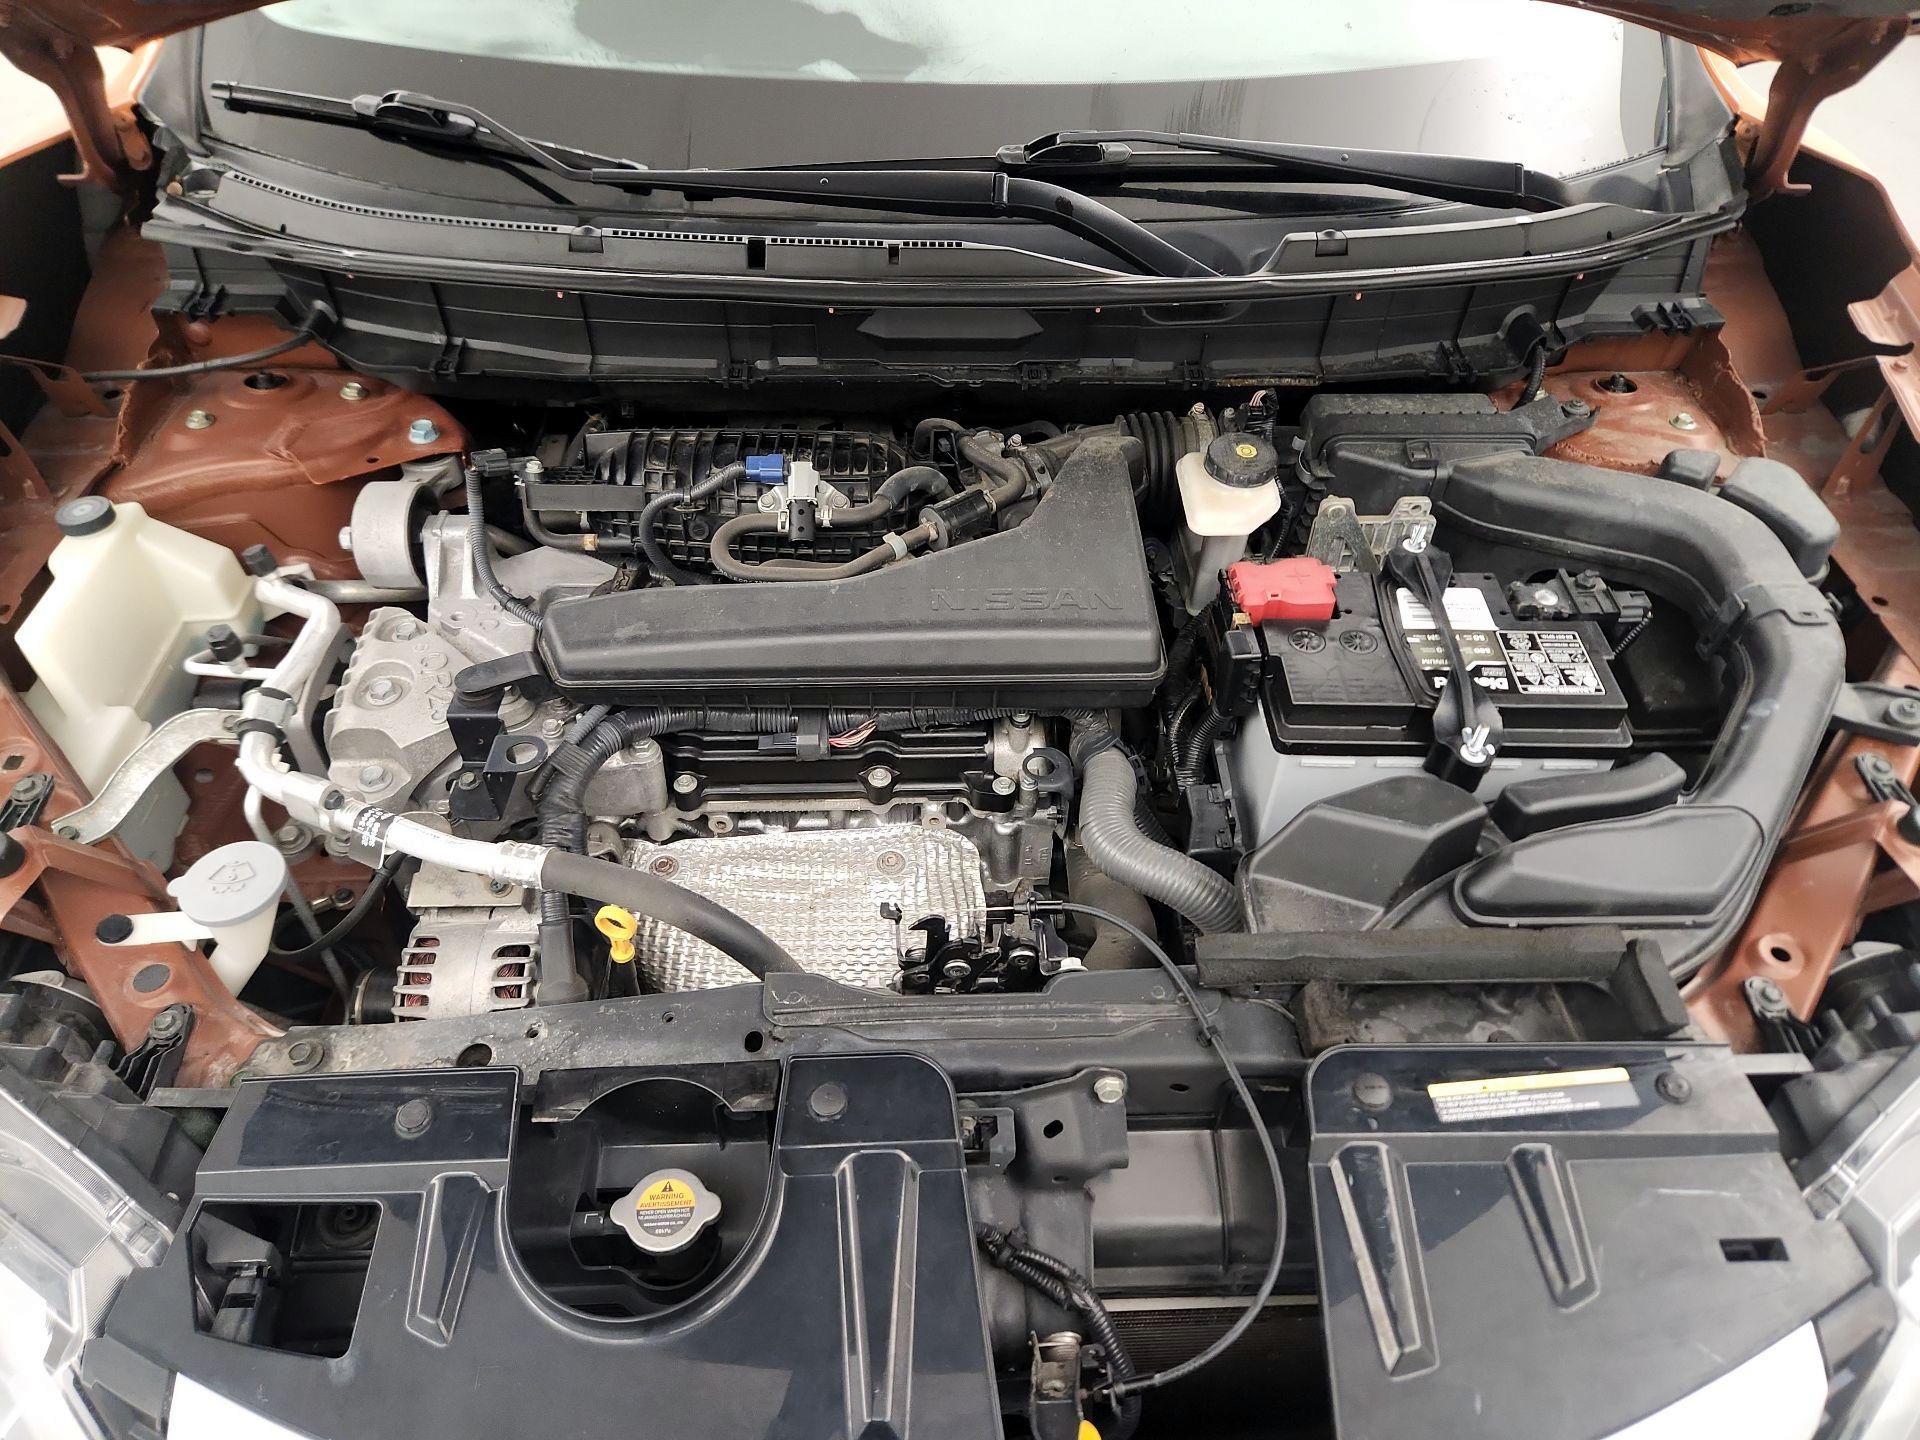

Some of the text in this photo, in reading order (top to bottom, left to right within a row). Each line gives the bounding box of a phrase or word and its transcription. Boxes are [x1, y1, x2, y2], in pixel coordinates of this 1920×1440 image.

[929, 586, 1124, 611] NISSAN
[649, 1192, 685, 1201] WARNING
[639, 1200, 692, 1208] AVERTISSEMENT
